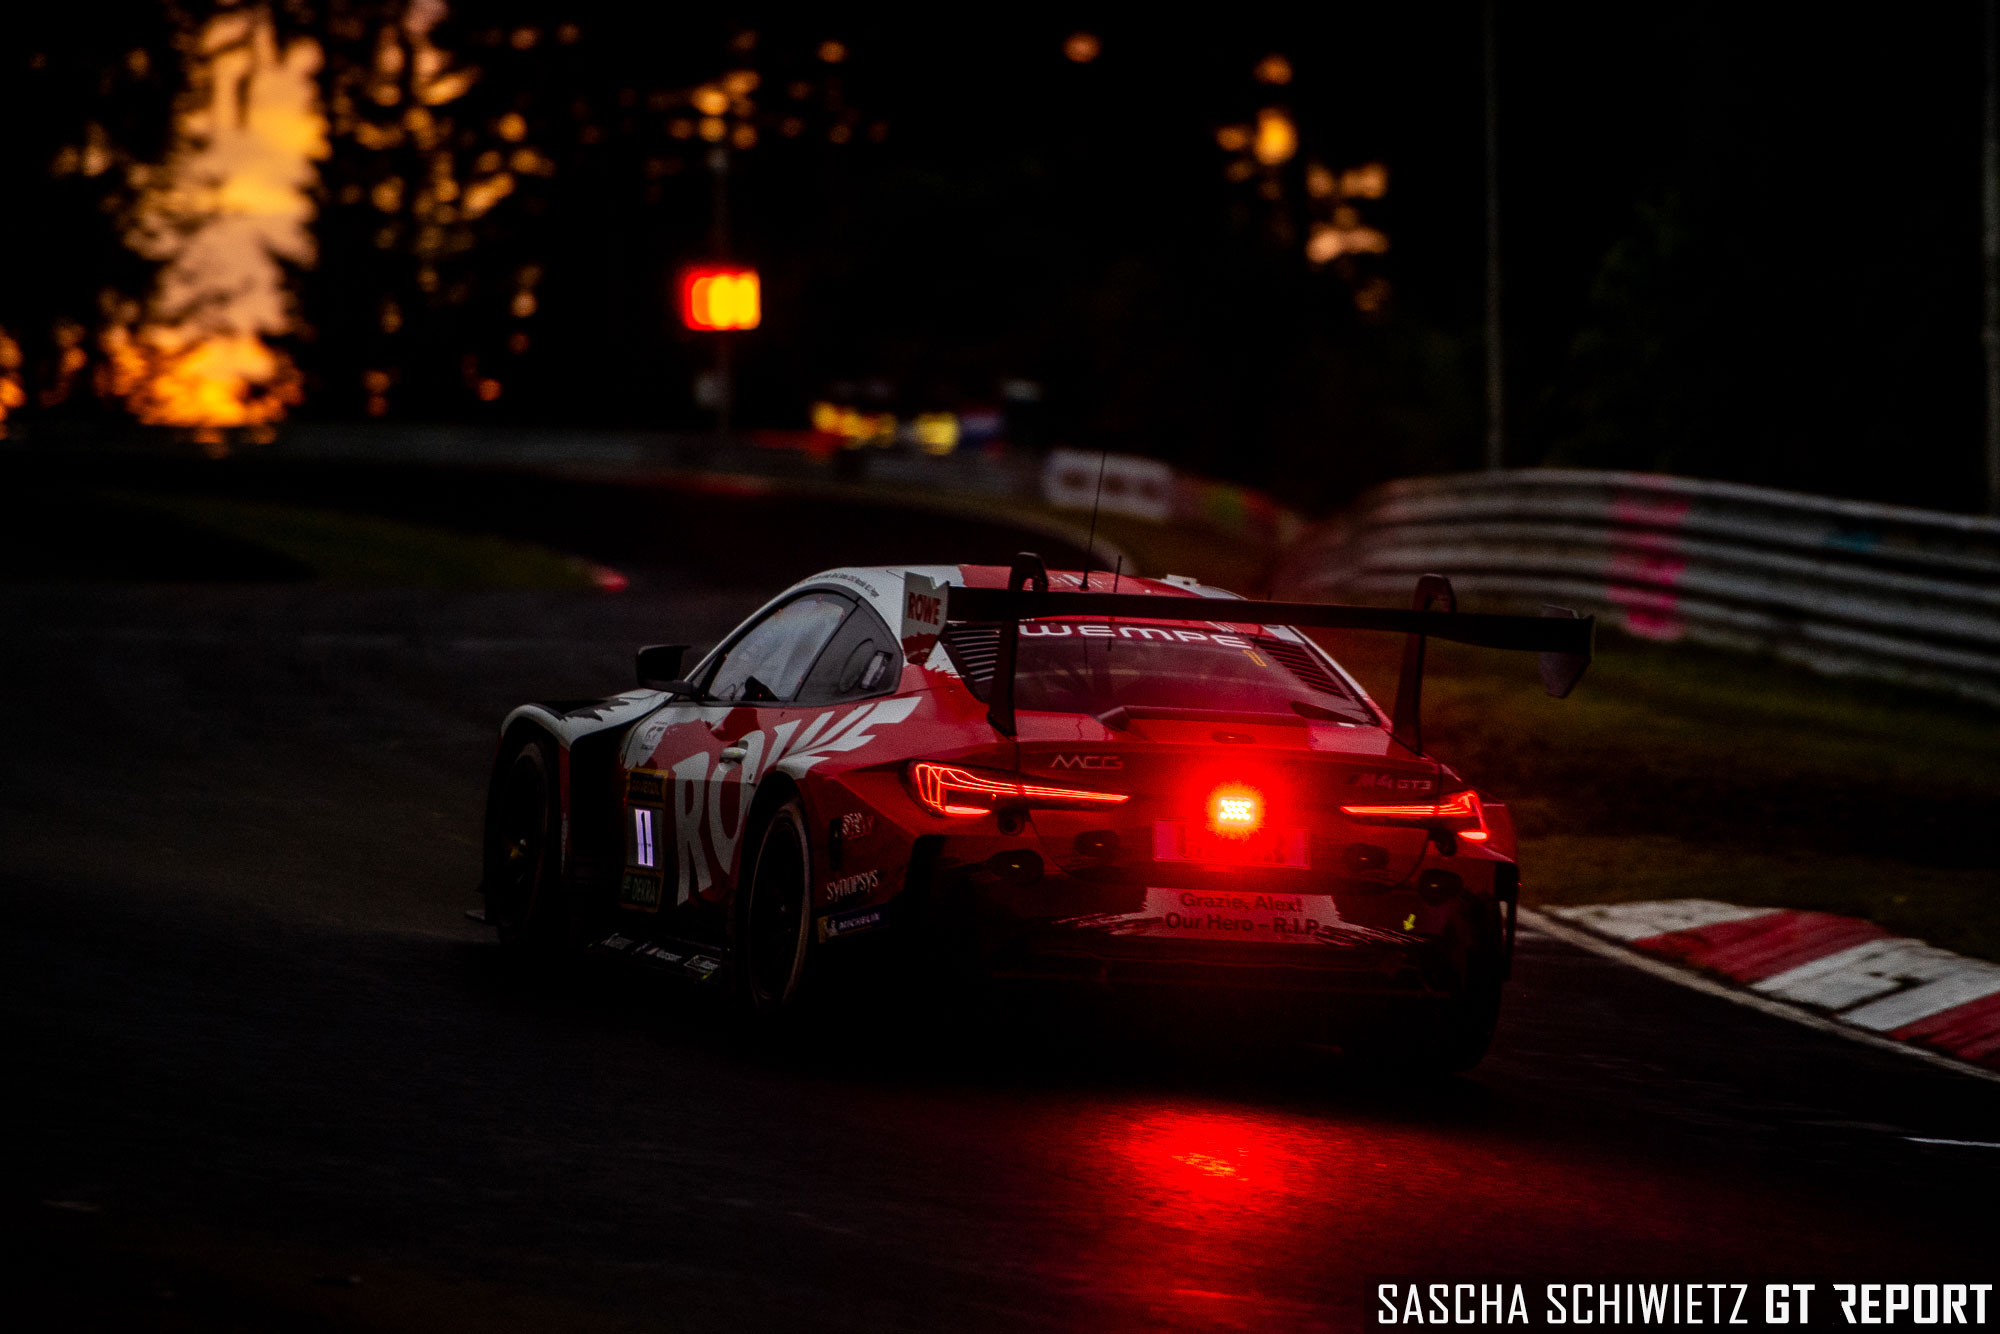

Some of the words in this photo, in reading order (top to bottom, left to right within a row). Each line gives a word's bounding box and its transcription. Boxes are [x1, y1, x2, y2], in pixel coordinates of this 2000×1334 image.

[907, 592, 941, 626] ROWE
[1019, 624, 1253, 649] WEMPE
[1179, 892, 1250, 911] Grazie,
[1253, 896, 1303, 913] Alex!
[1166, 912, 1203, 929] Our
[1207, 914, 1253, 931] Hero
